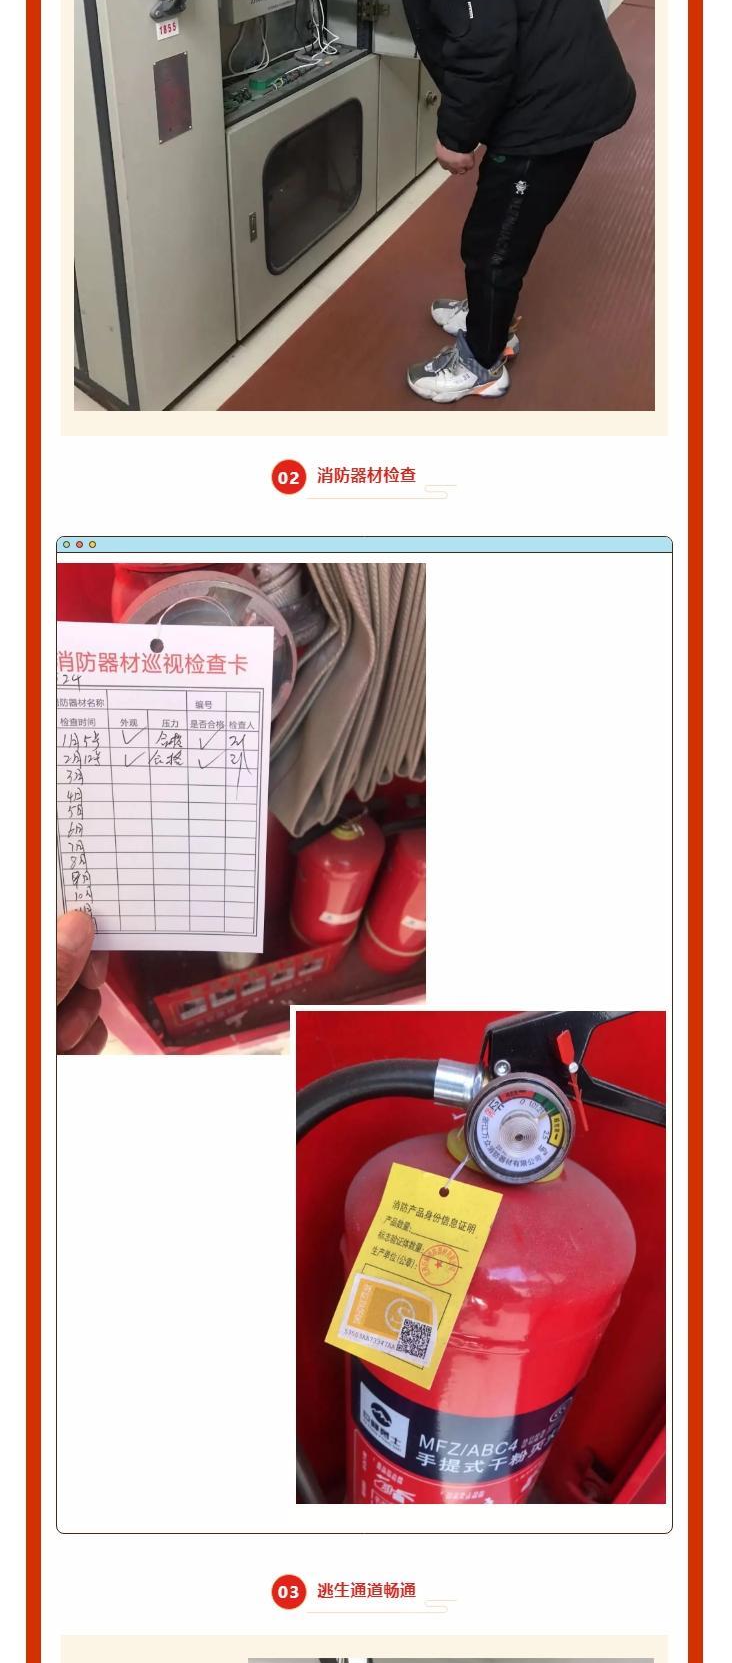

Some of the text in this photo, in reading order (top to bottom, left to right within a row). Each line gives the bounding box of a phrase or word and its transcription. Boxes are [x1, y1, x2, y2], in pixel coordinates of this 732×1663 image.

[159, 22, 177, 36] 1855
[278, 467, 416, 485] 02 消防器材检查
[195, 700, 213, 710] 编号
[60, 717, 255, 730] 检查时间 外观 压力 是否合格 检查人
[391, 1199, 477, 1235] 消防产品身份信息证明
[418, 1433, 519, 1458] MFZ/ABC4
[278, 1582, 416, 1599] 03 逃生通道畅通
